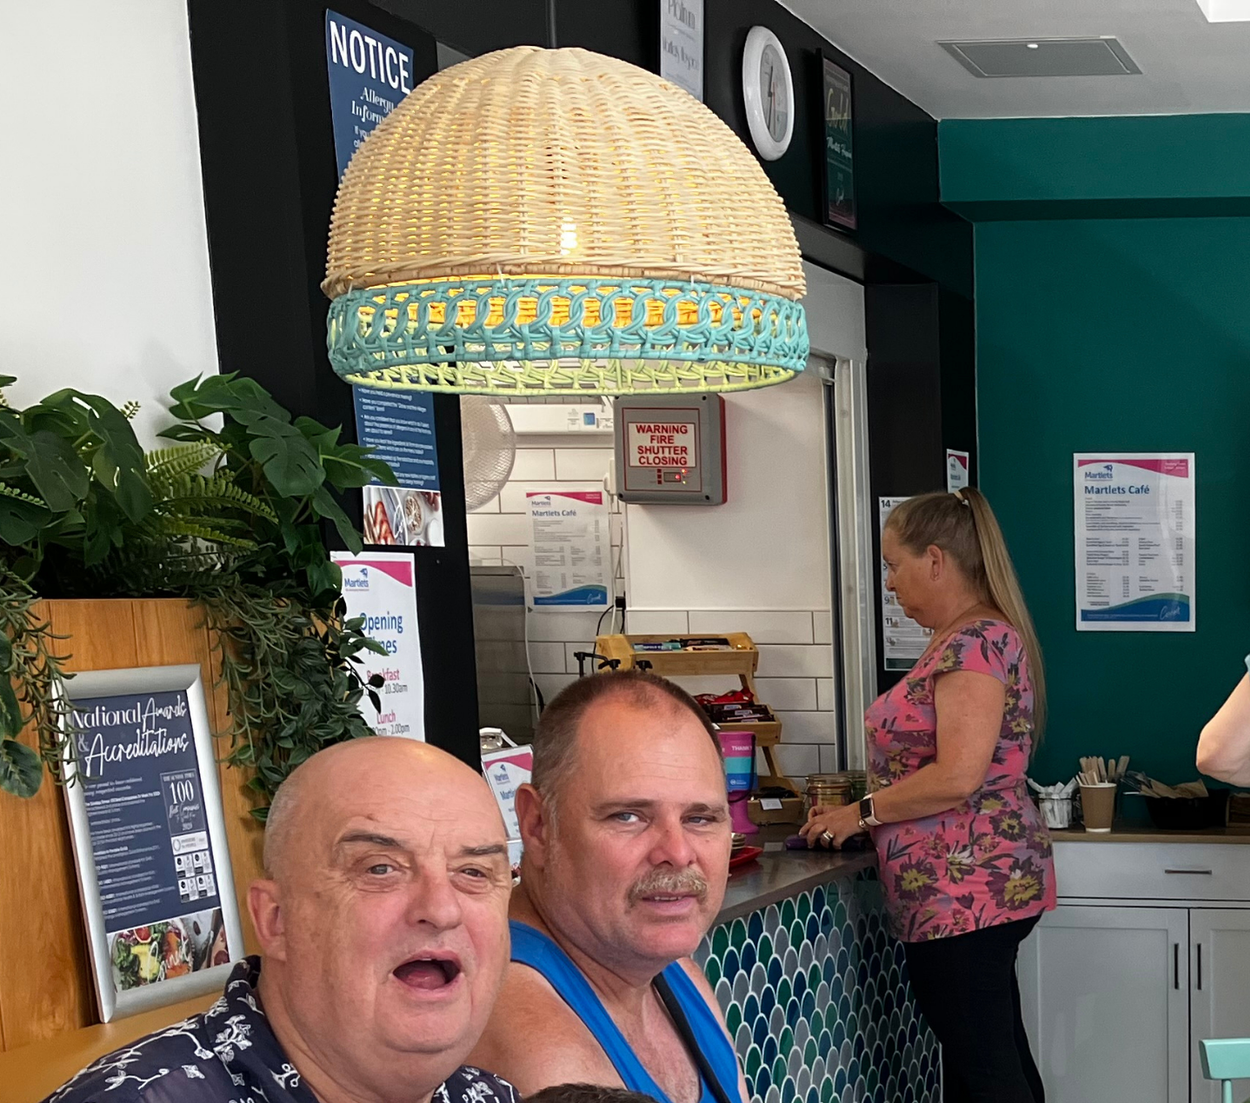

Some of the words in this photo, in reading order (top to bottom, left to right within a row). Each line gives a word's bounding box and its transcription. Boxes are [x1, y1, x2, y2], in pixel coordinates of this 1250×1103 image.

[330, 20, 411, 95] NOTICE
[352, 100, 385, 122] Inform
[636, 425, 688, 434] WARNING
[650, 435, 675, 444] FIRE
[637, 445, 688, 455] SHUTTER
[638, 456, 687, 466] CLOSING
[1084, 485, 1126, 495] Martlets
[1128, 484, 1150, 495] Café
[881, 500, 891, 508] 14
[345, 578, 369, 587] Martlets
[360, 611, 404, 634] Opening
[72, 702, 141, 729] National
[377, 710, 396, 724] Lunch
[85, 727, 189, 777] Accreditations
[169, 779, 194, 804] 100
